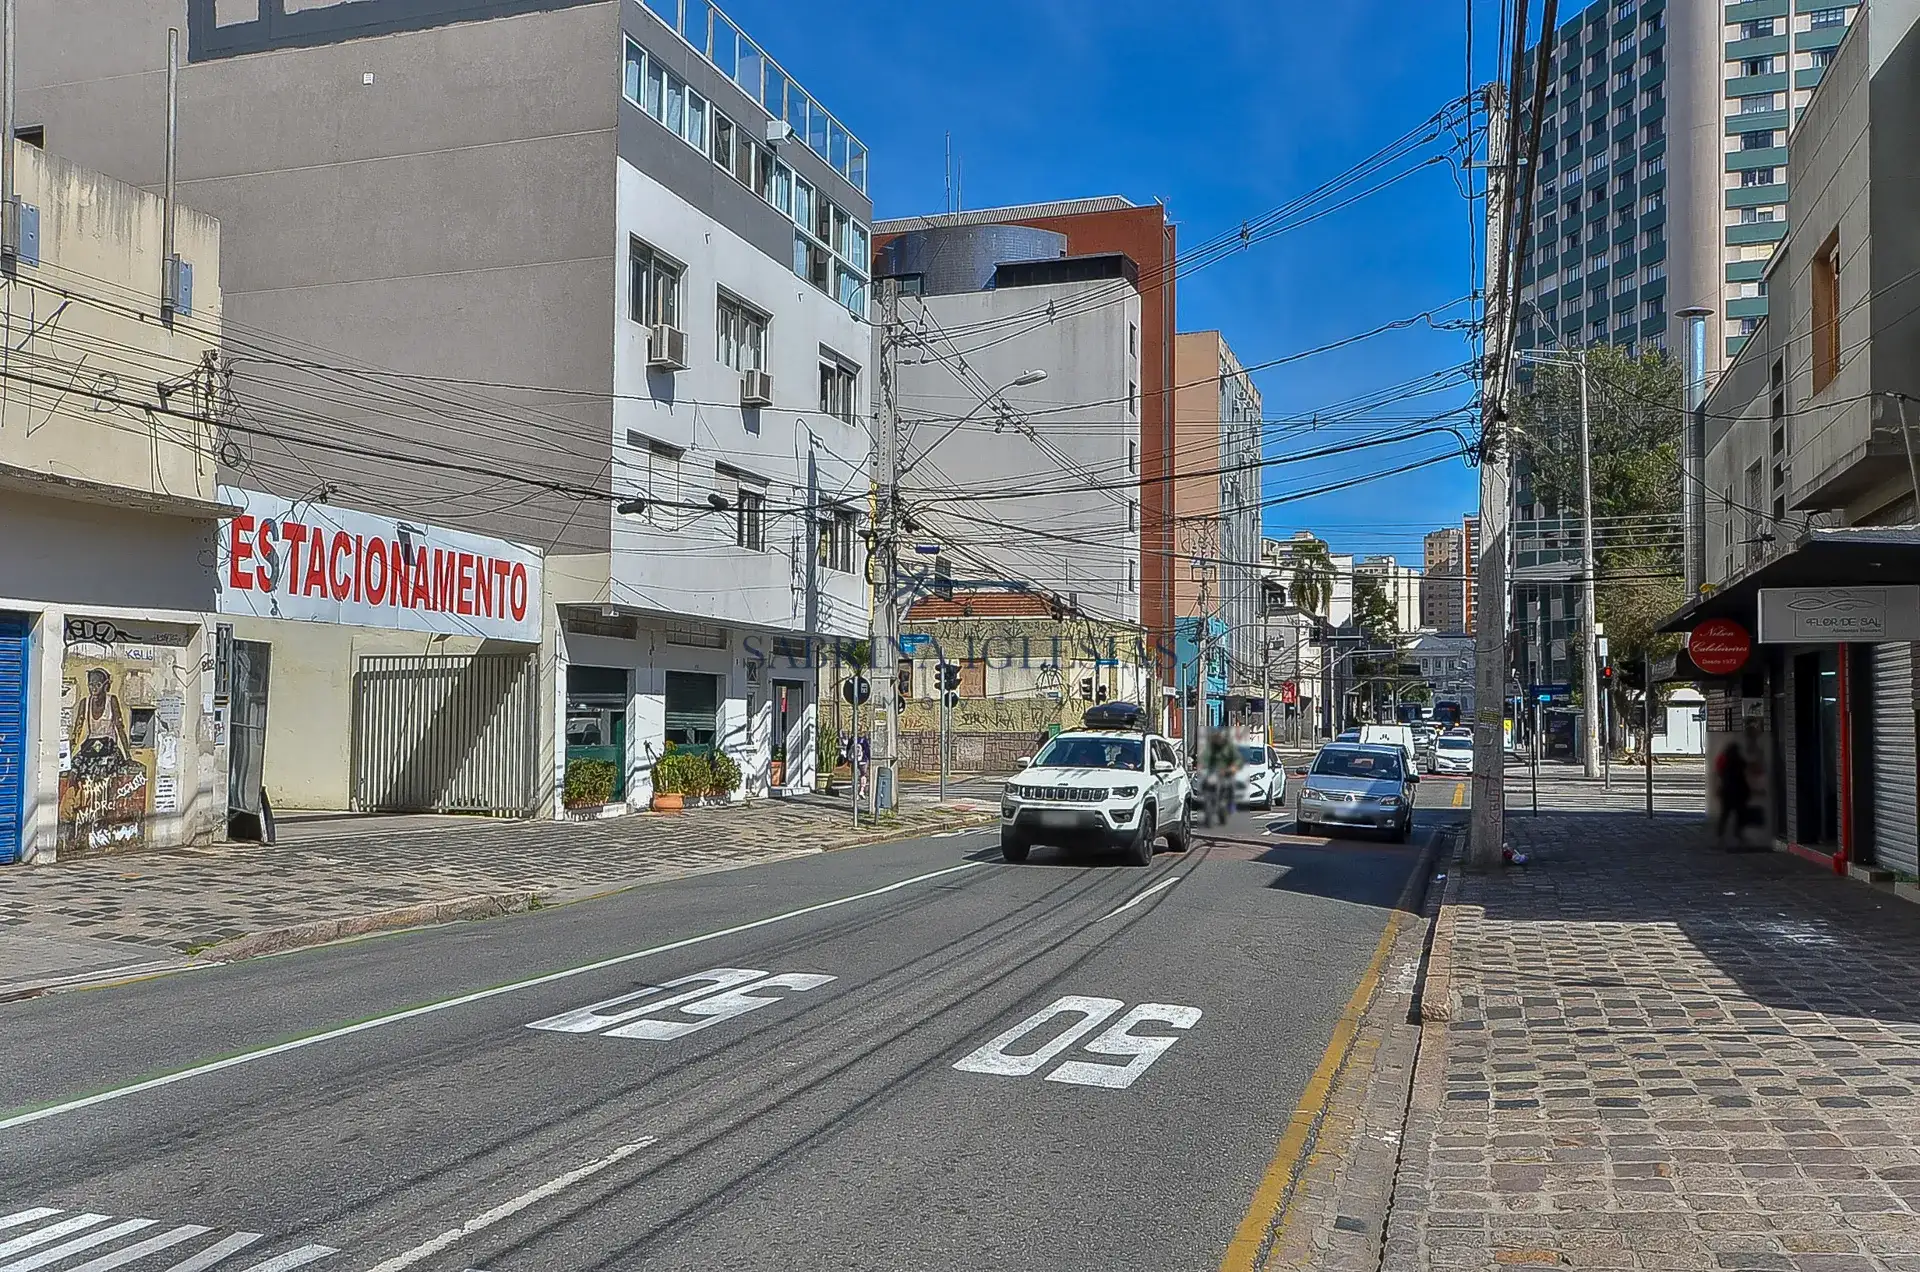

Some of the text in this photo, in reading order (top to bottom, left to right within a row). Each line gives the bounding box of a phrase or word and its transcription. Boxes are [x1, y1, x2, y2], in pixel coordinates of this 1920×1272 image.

[229, 514, 528, 622] ESTACIONAMENTO
[1806, 617, 1882, 628] FLOR DE SAL
